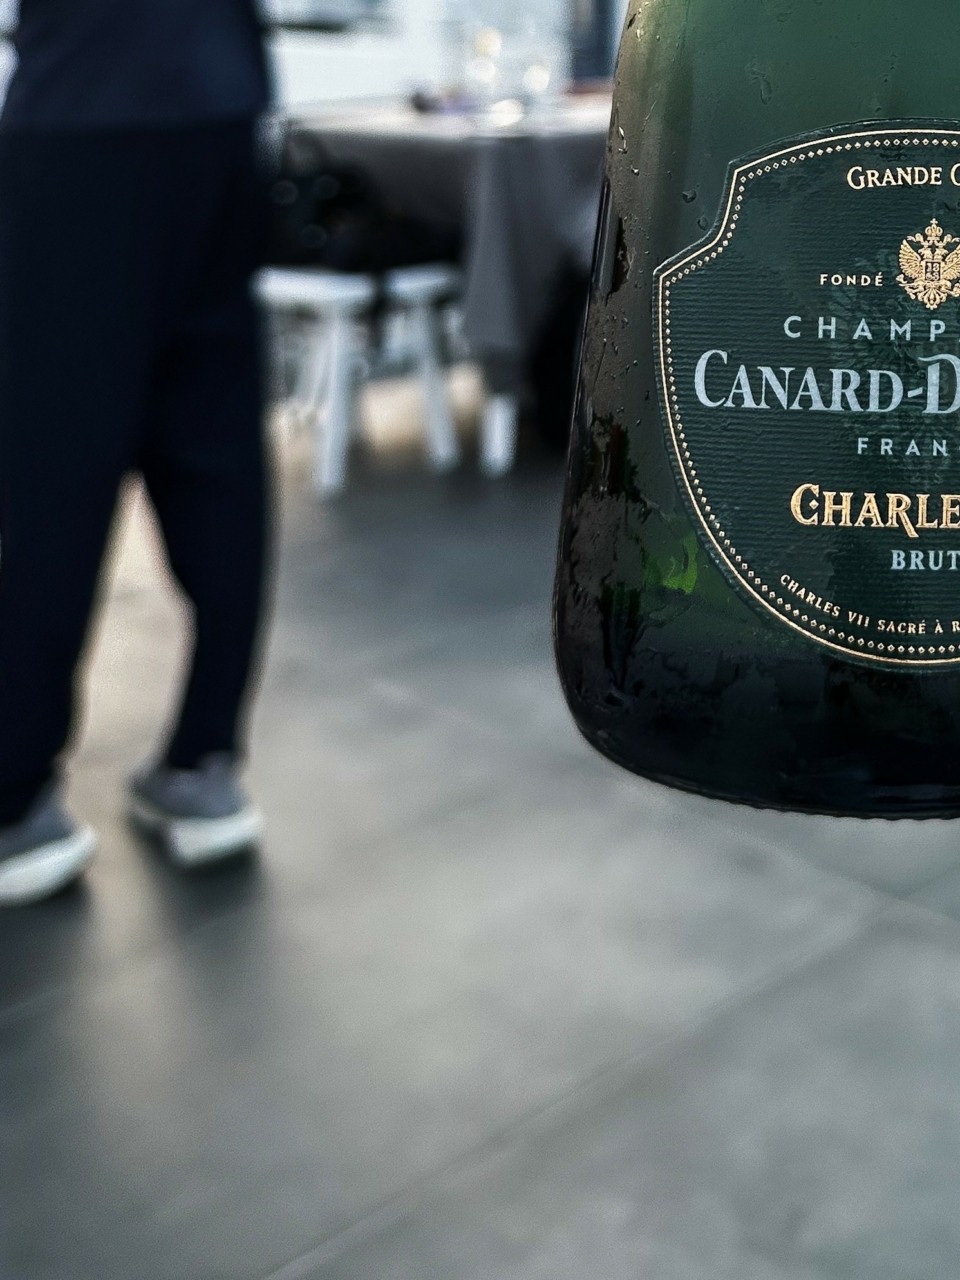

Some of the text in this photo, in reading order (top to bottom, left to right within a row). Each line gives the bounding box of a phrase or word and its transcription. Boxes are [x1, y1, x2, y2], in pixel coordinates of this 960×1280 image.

[846, 166, 943, 190] GRANDE
[819, 271, 884, 287] FONDÉ
[780, 574, 841, 617] CHARLES
[848, 611, 870, 628] VII
[877, 619, 927, 635] SACRÉ
[934, 619, 944, 634] À
